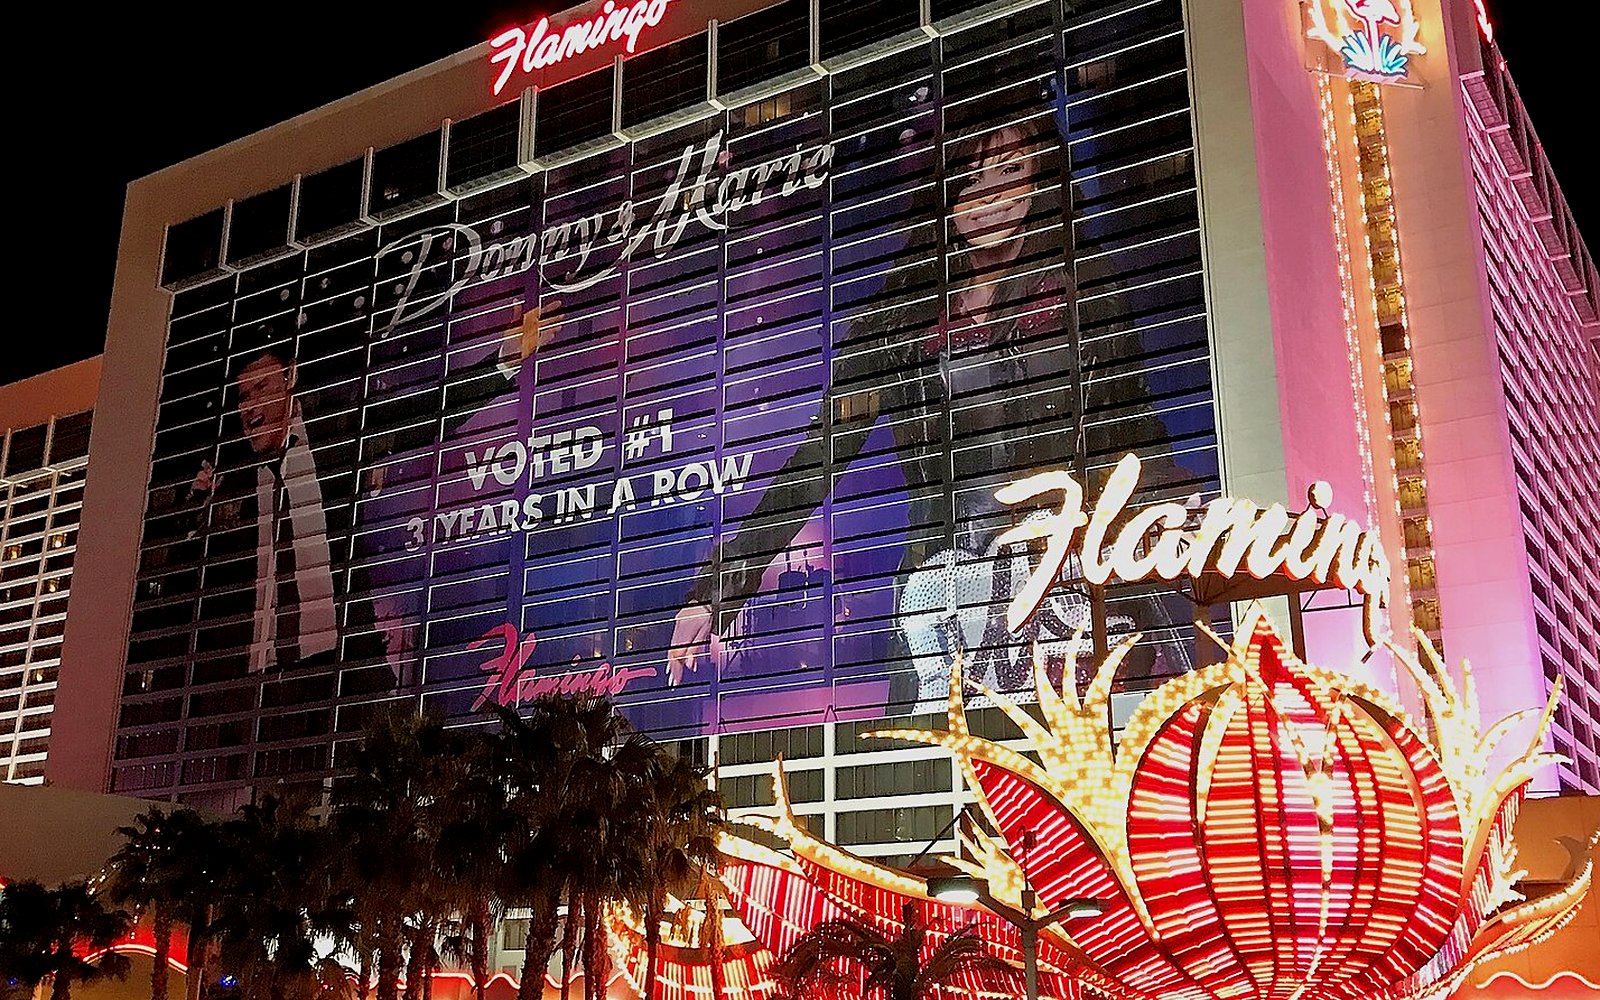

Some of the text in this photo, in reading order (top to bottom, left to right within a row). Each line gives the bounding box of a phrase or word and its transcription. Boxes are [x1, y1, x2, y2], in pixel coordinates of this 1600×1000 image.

[491, 0, 671, 95] Flamingo
[366, 129, 835, 338] Donny & Marie
[464, 408, 674, 491] VOTED #1
[404, 454, 754, 552] 3 YEARS IN A ROW
[994, 452, 1391, 650] Flaming
[466, 622, 657, 713] Flamingo
